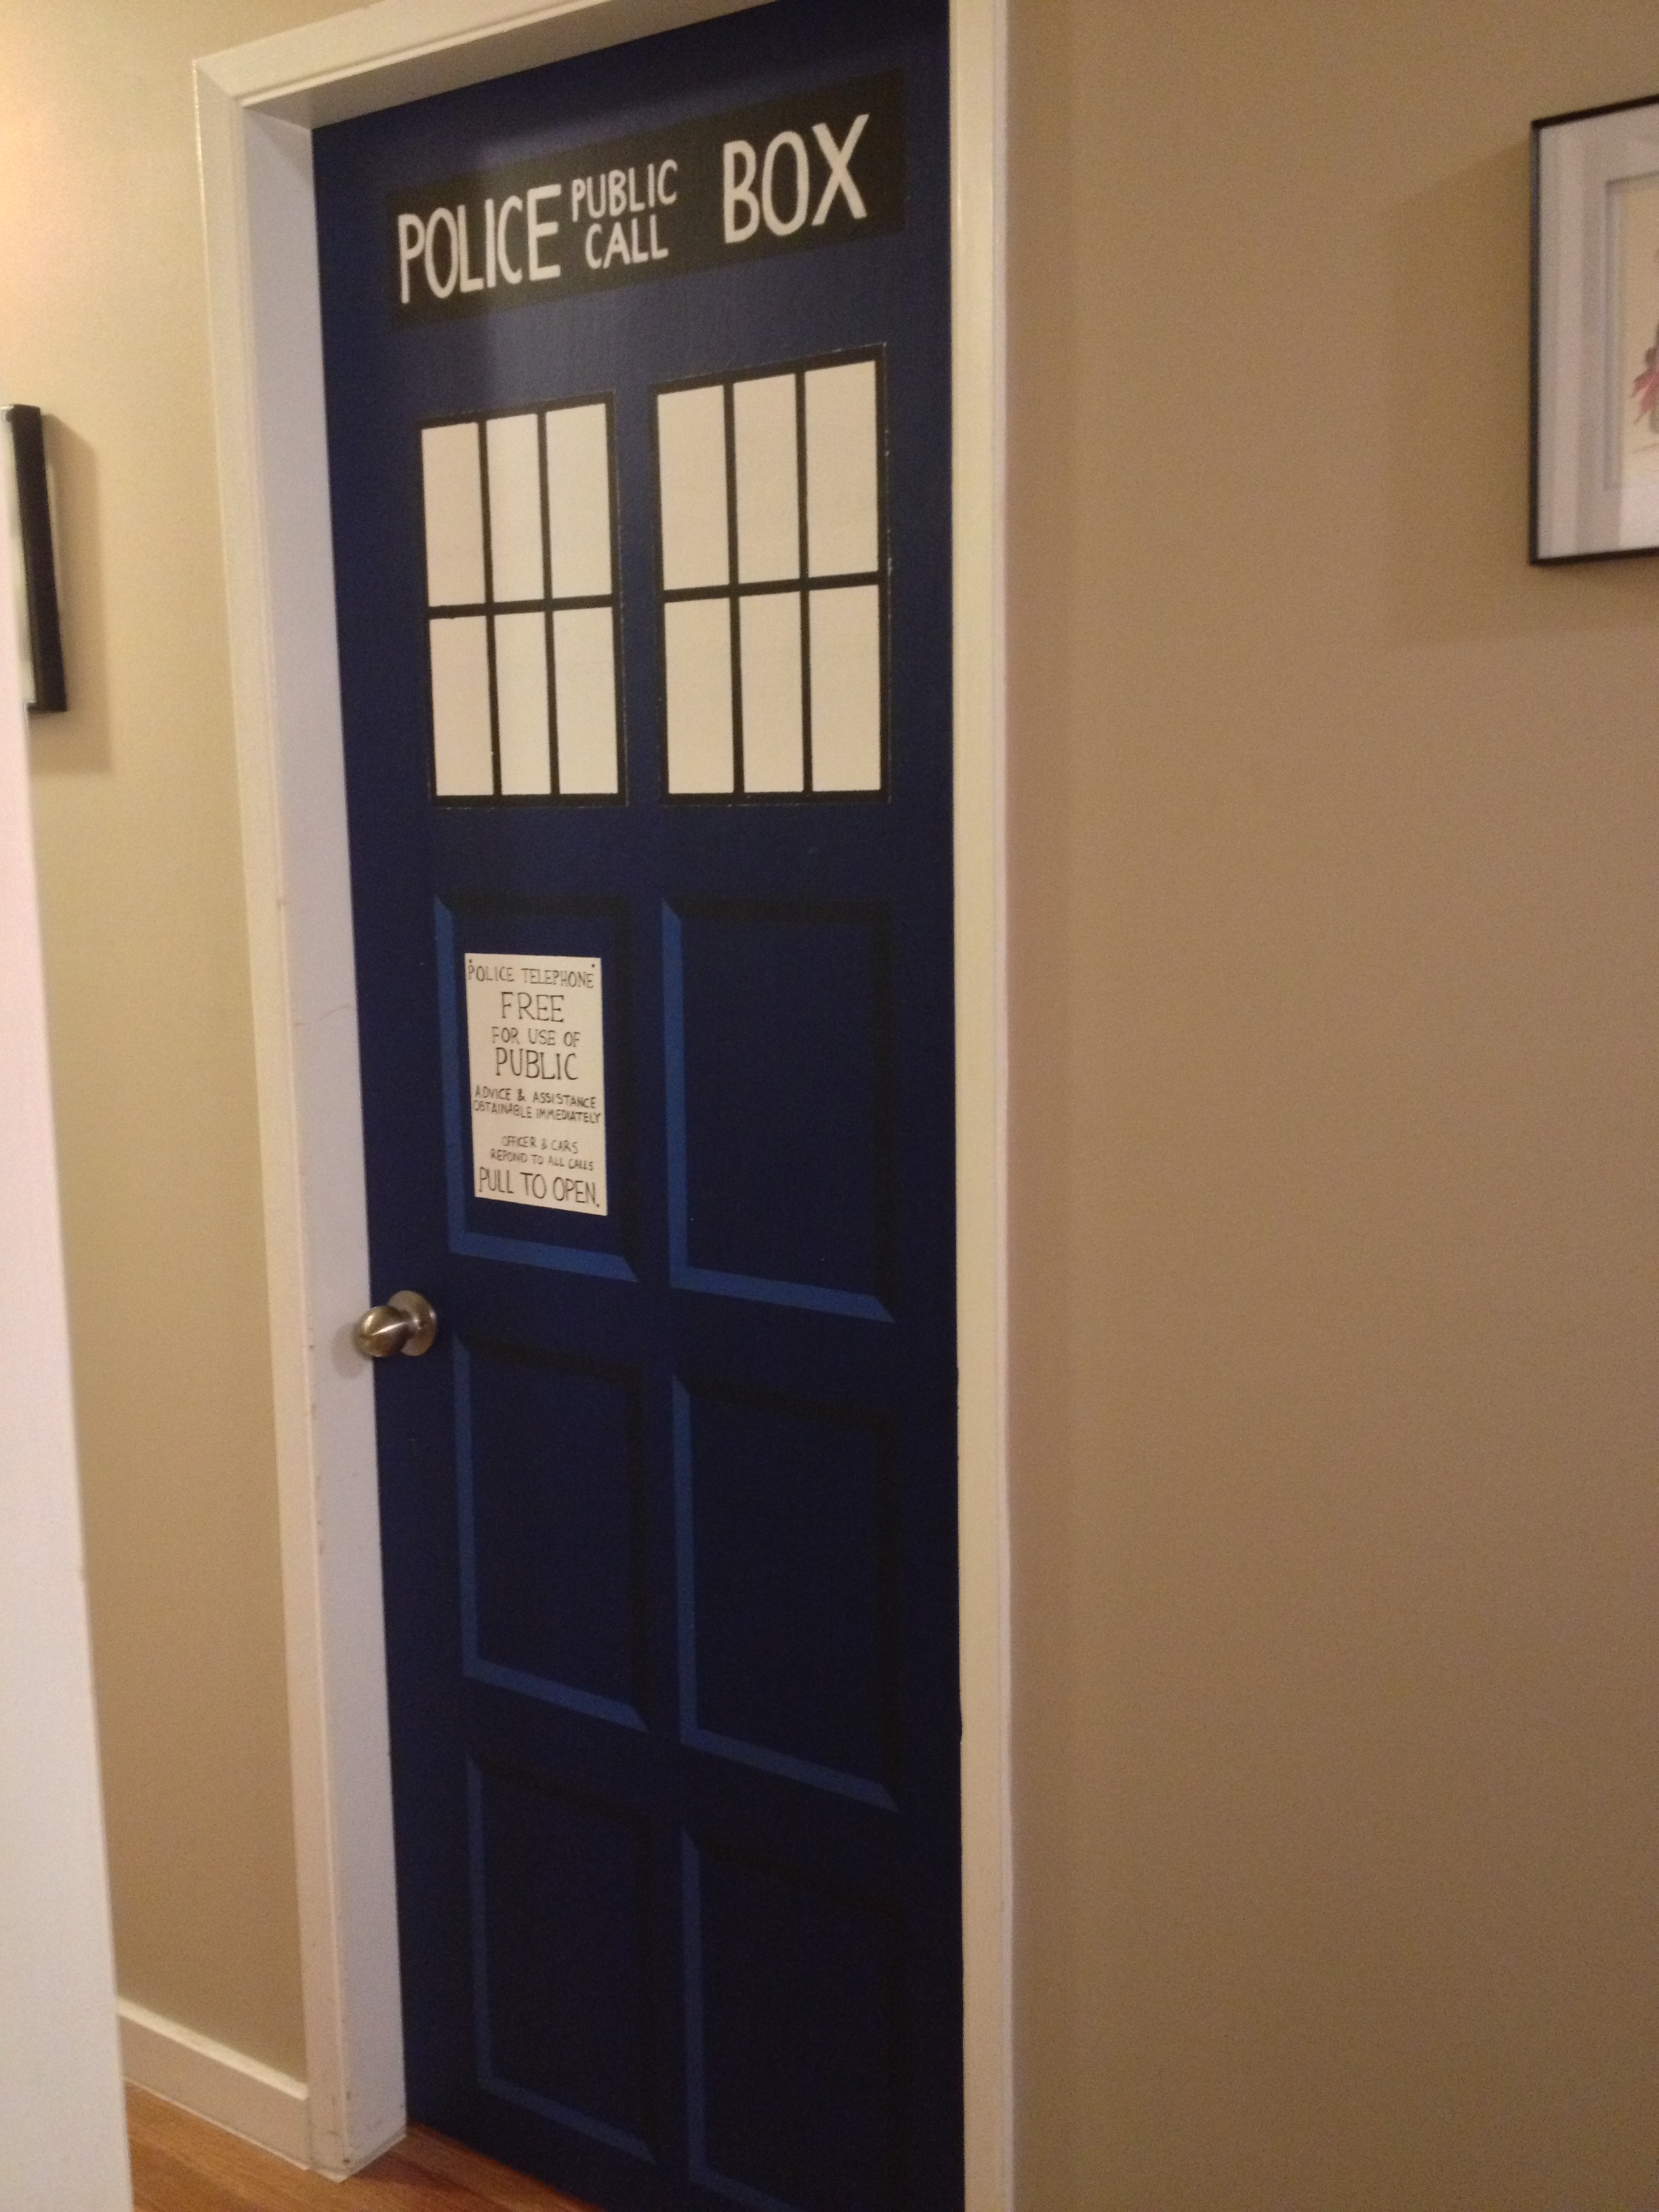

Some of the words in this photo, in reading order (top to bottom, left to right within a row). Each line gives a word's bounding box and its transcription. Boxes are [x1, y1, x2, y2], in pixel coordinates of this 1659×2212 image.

[571, 159, 678, 222] PUBLIC
[723, 113, 869, 244] BOX
[398, 184, 562, 304] POLICE
[585, 215, 669, 270] CALL
[468, 964, 514, 982] POLICE
[521, 968, 594, 989] TELEPHONE
[501, 991, 565, 1023] FREE
[491, 1026, 520, 1044] FOR
[528, 1028, 556, 1046] USE
[563, 1031, 581, 1047] OF
[495, 1047, 578, 1080] PUBLIC
[474, 1100, 532, 1118] OBTAINABLE
[536, 1108, 601, 1124] IMMEDIATELY
[475, 1086, 512, 1101] ADVICE
[517, 1088, 527, 1102] &
[533, 1091, 596, 1109] ASSISTANCE
[501, 1135, 537, 1149] OFFICER
[551, 1139, 579, 1153] CARS
[531, 1154, 544, 1165] TO
[548, 1155, 565, 1167] ALL
[568, 1158, 594, 1171] CALLS
[478, 1166, 514, 1193] PULL
[520, 1172, 547, 1200] TO
[552, 1176, 600, 1208] OPEN.
